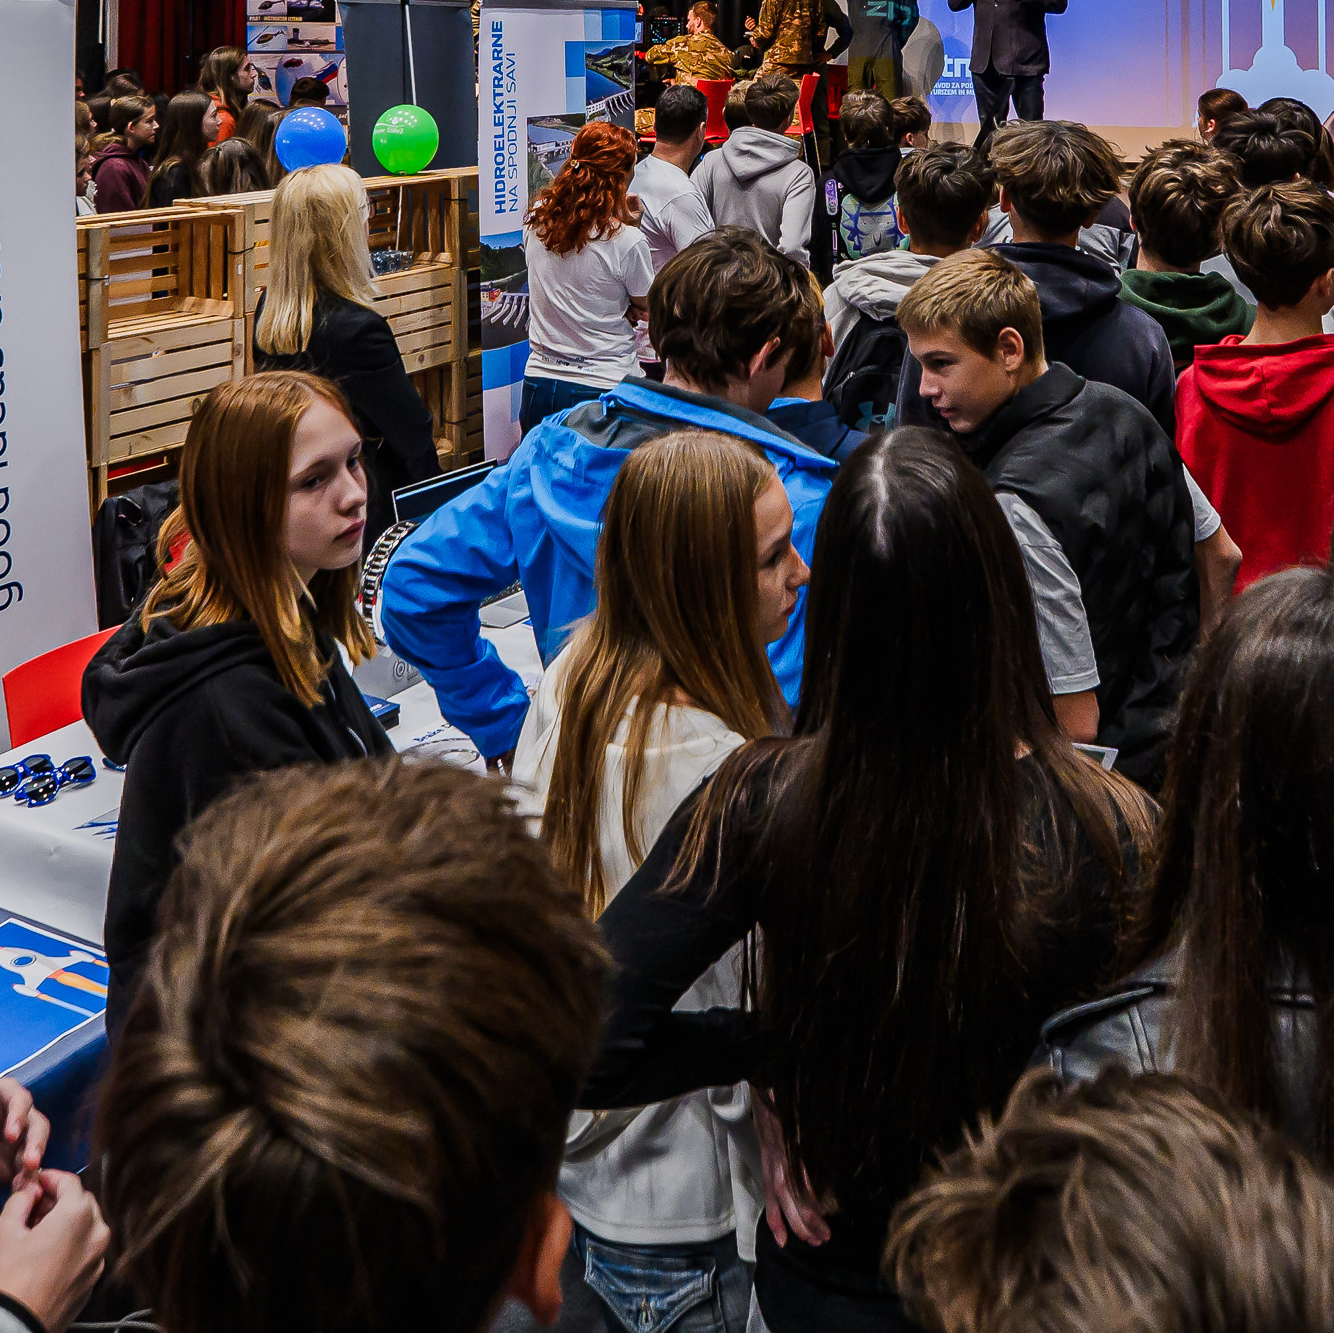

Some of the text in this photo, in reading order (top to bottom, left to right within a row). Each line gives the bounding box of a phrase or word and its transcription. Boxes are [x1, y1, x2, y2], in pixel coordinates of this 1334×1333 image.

[491, 20, 507, 215] HIDROELEKTRARNE
[505, 52, 519, 213] NA SPODNJI SAVI
